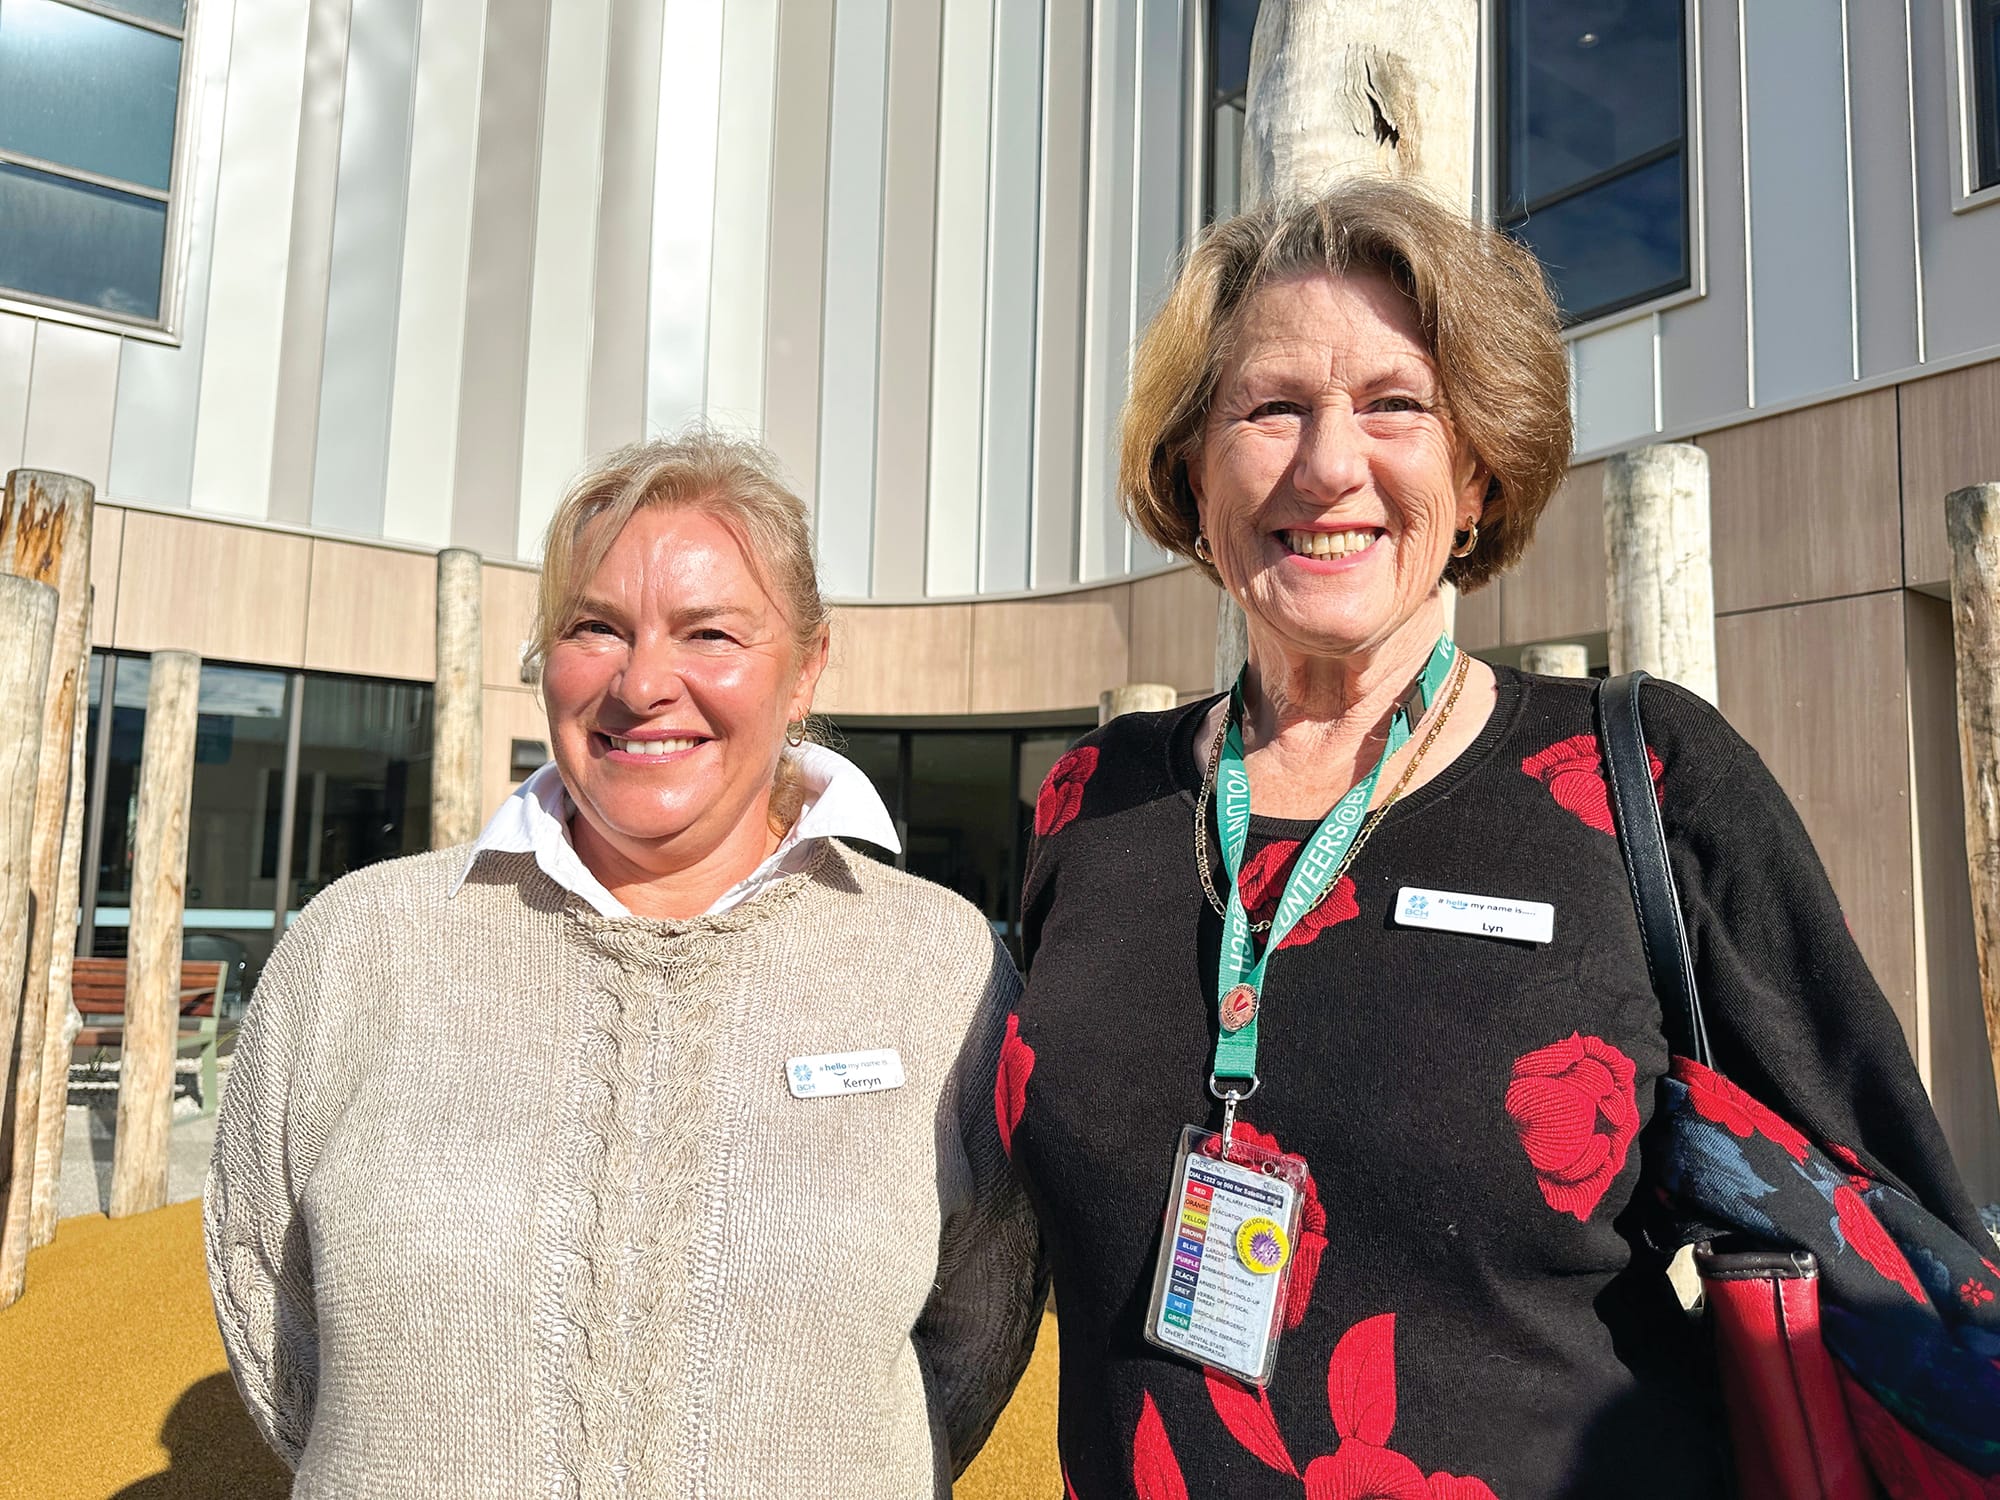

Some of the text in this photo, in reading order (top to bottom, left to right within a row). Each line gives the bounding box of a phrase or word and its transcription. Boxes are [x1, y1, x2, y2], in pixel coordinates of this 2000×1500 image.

[1405, 908, 1429, 917] BCH
[1446, 899, 1469, 907] hello
[1470, 902, 1484, 910] my
[1487, 904, 1512, 913] name
[1482, 922, 1504, 933] Lyn
[825, 1062, 847, 1071] hello
[860, 1060, 880, 1068] name
[843, 1077, 882, 1089] Kerryn
[1191, 1158, 1227, 1175] EMERGENCY
[1189, 1170, 1201, 1180] DIAL
[1234, 1184, 1243, 1193] for
[1193, 1186, 1206, 1196] RED
[1184, 1198, 1209, 1211] ORANGE
[1214, 1192, 1273, 1216] FIRE ALARM ACTIVATION
[1183, 1213, 1207, 1227] YELLOW
[1212, 1207, 1243, 1222] EVACUATION
[1181, 1227, 1203, 1240] BROWN
[1210, 1223, 1233, 1235] INTERNAL
[1182, 1241, 1198, 1252] BLUE
[1207, 1236, 1231, 1249] EXTERNAL
[1204, 1253, 1224, 1263] ARREST
[1205, 1246, 1227, 1258] CARDIAC
[1176, 1254, 1200, 1268] PURPLE
[1174, 1269, 1195, 1282] BLACK
[1234, 1275, 1255, 1287] THREAT
[1172, 1284, 1191, 1297] GREY
[1198, 1279, 1216, 1290] ARMED
[1196, 1297, 1215, 1308] THREAT
[1197, 1290, 1215, 1302] VERBAL
[1225, 1299, 1249, 1315] PHYSICAL
[1167, 1312, 1189, 1327] GREEN
[1194, 1308, 1247, 1333] MEDICAL EMERGENCY
[1191, 1322, 1251, 1349] OBSTETRIC EMERGENCY
[1189, 1333, 1225, 1352] MENTAL STATE
[1187, 1340, 1227, 1359] DETERIORATION
